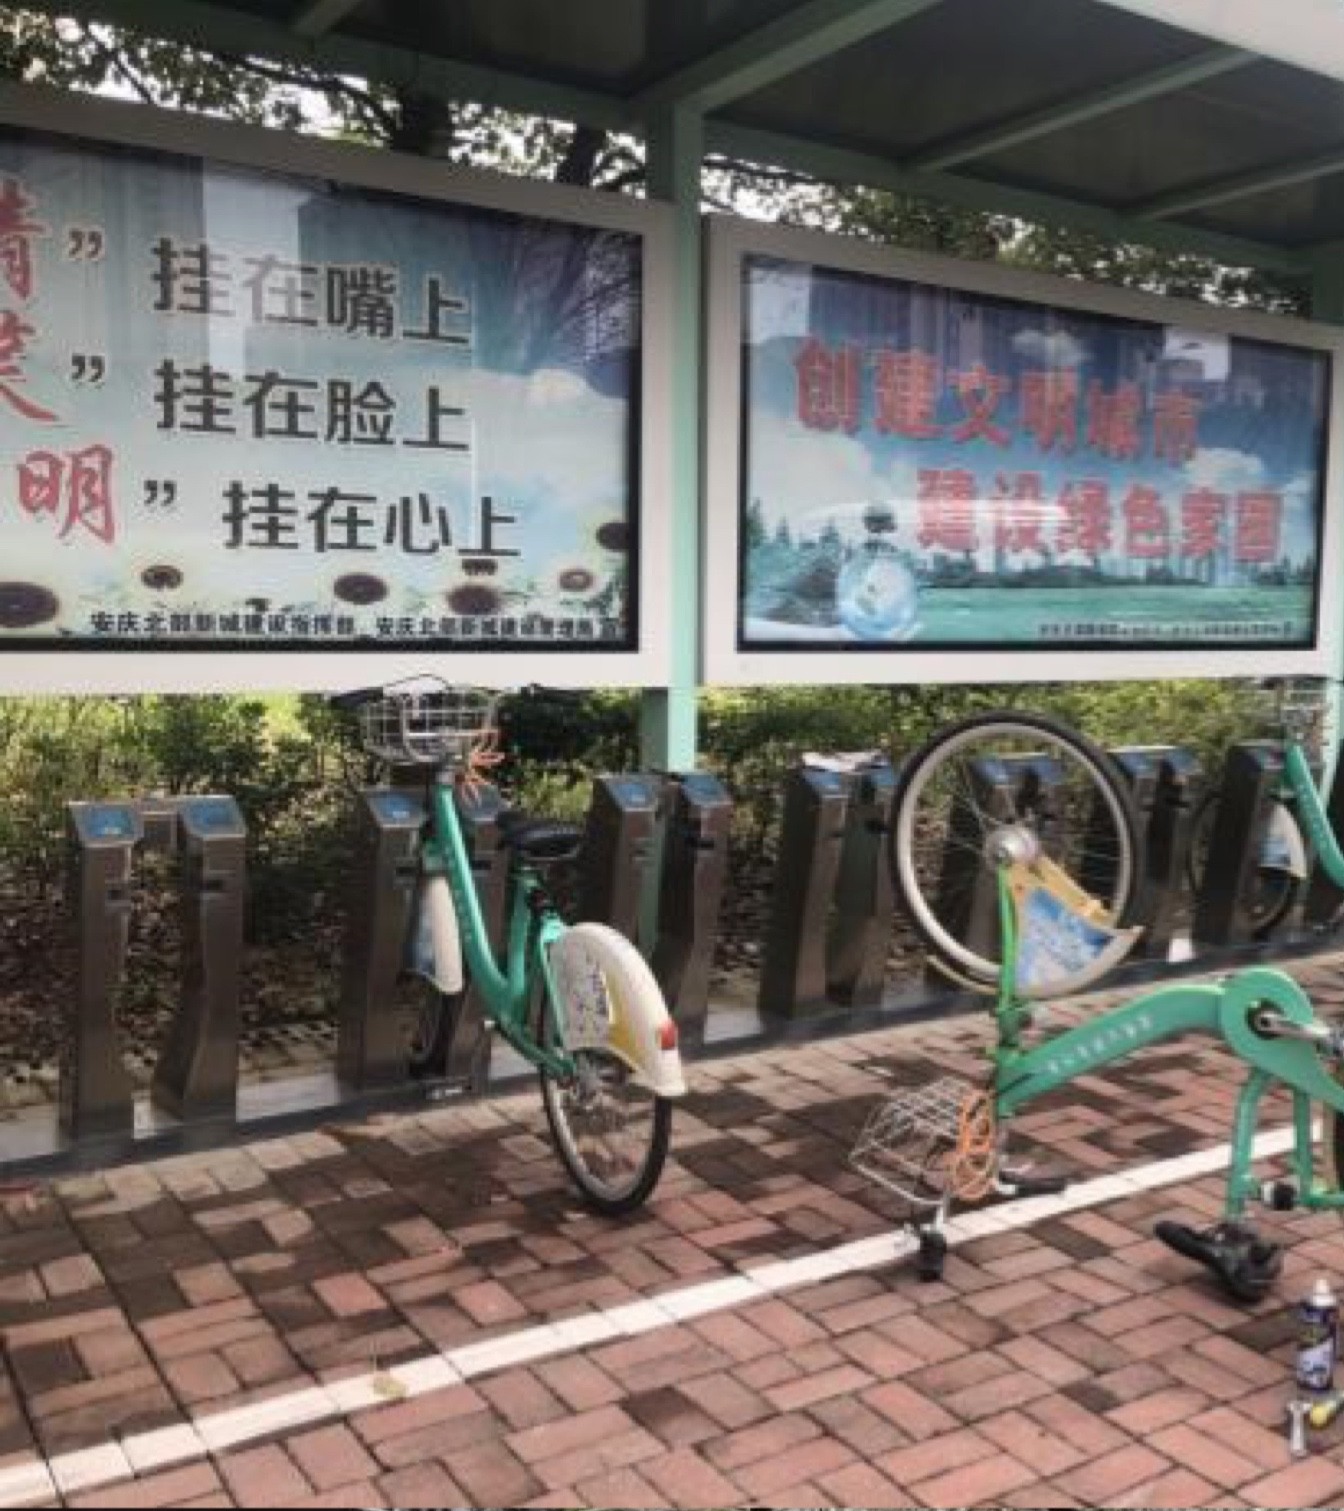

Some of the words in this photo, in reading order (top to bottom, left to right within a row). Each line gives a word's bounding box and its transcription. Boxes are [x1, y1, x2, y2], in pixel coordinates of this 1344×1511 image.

[150, 236, 470, 345] 挂在嘴上
[152, 358, 470, 451] 挂在脸上
[793, 331, 1201, 466] 创建文明城市
[221, 480, 521, 557] 挂在心上
[915, 469, 1284, 563] 建设绿色家园
